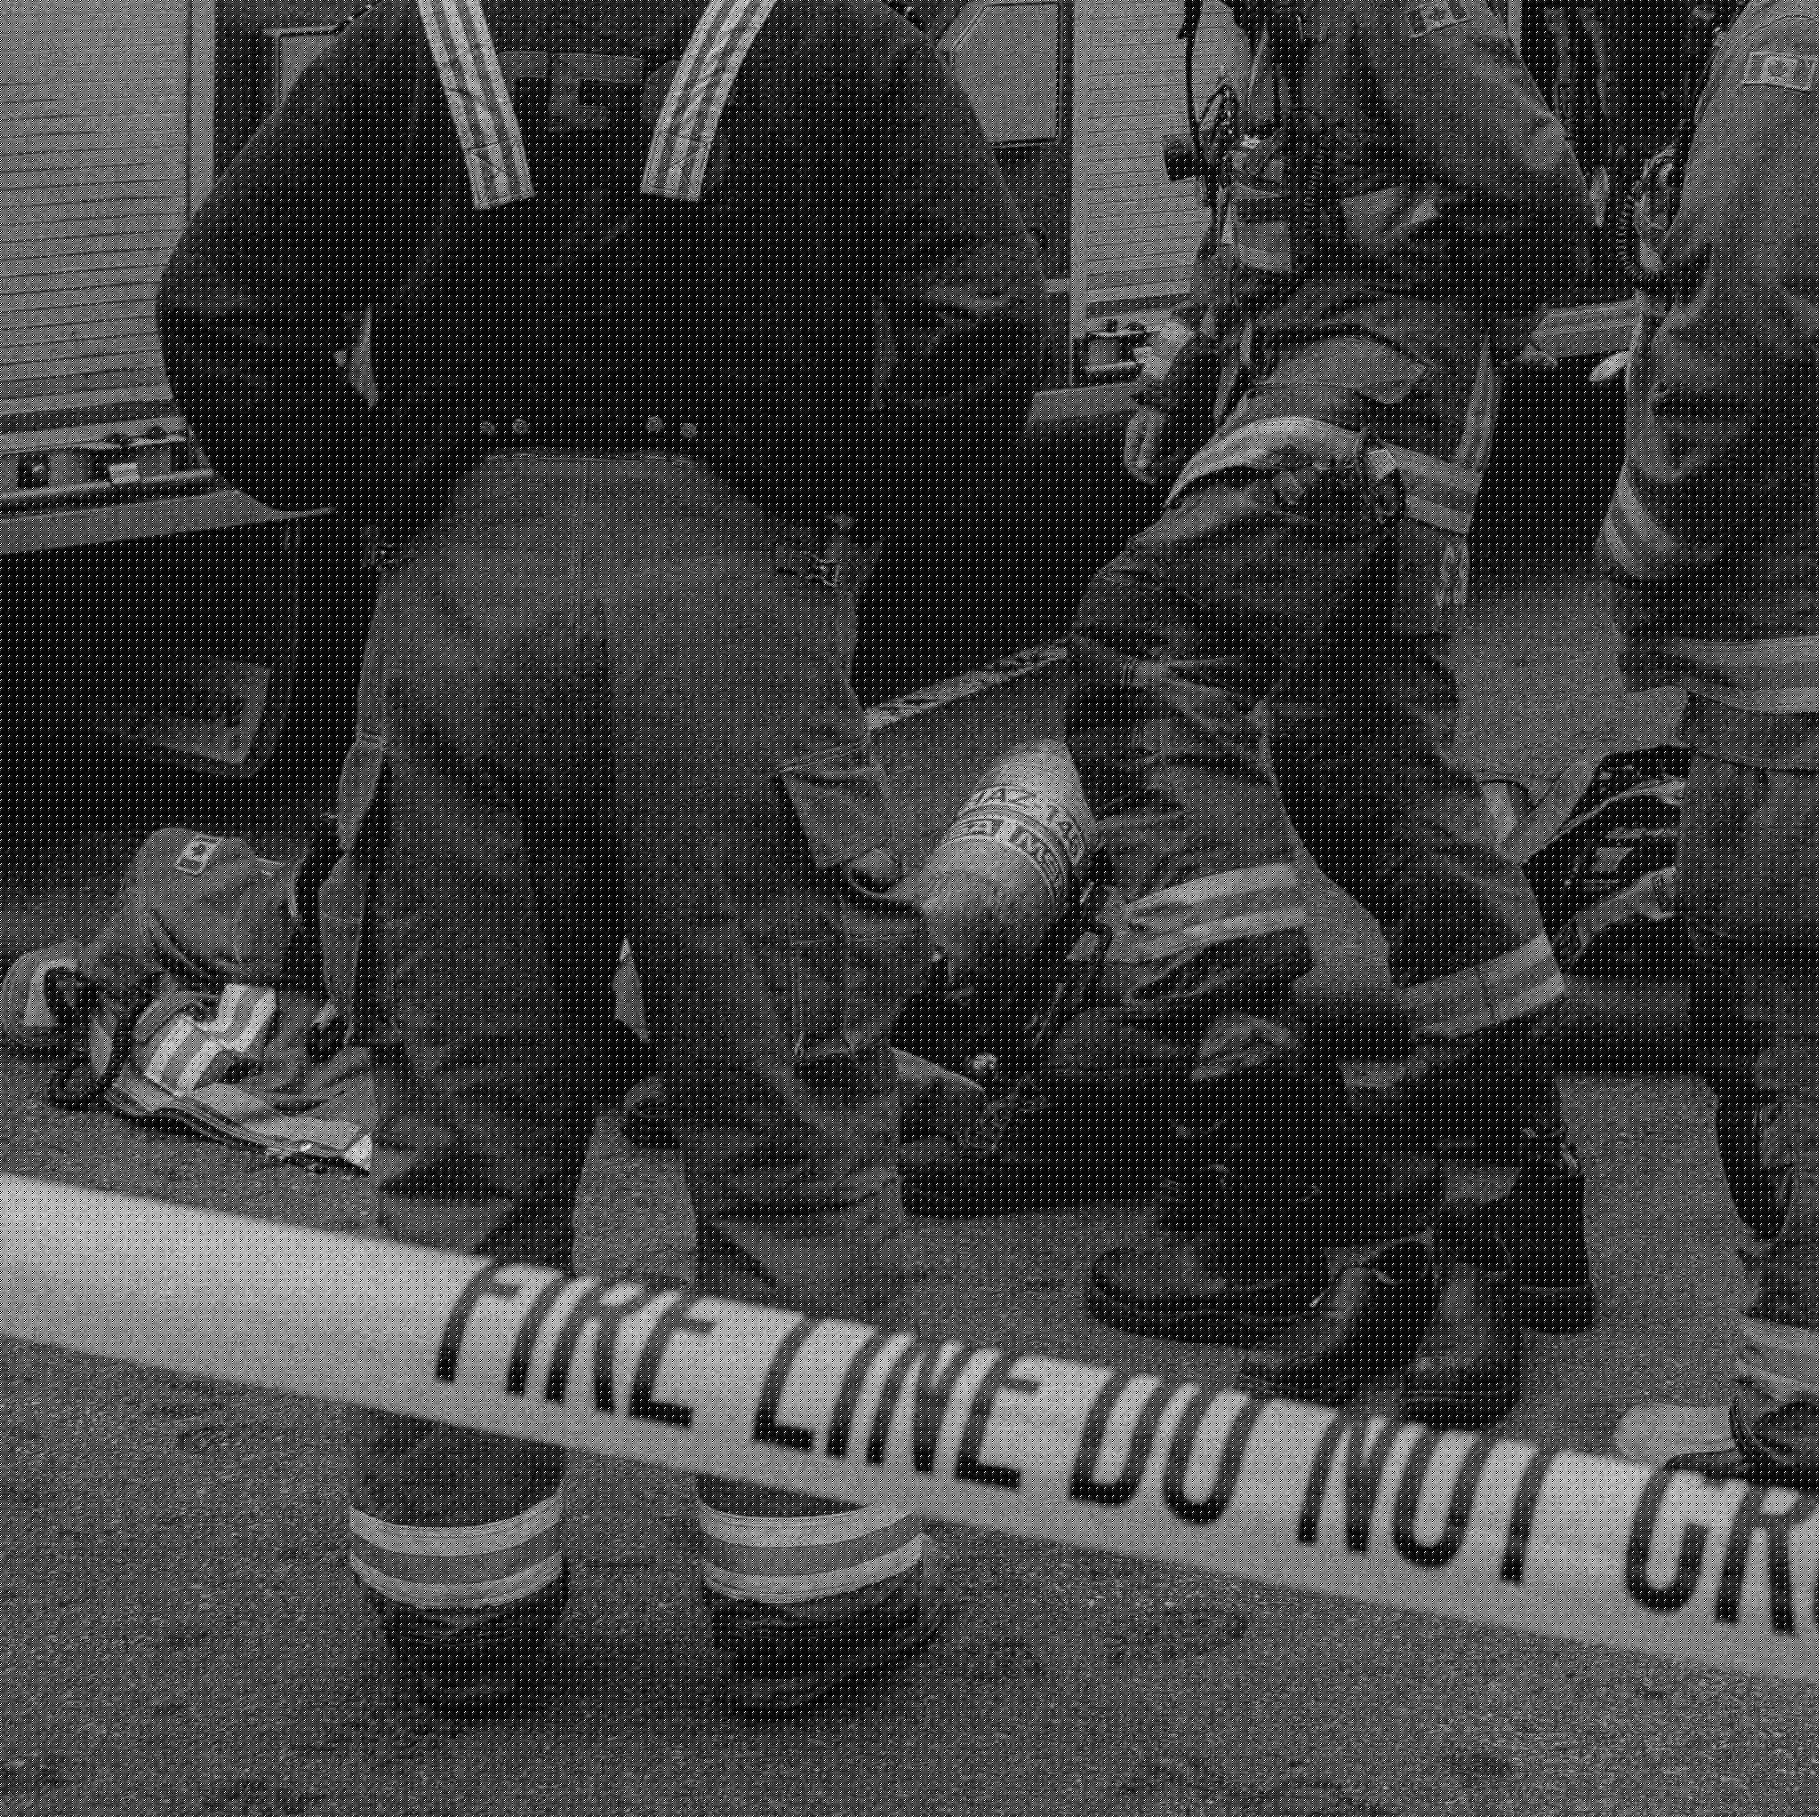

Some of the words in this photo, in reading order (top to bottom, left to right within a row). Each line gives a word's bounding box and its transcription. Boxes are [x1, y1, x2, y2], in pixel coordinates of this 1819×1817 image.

[436, 1264, 716, 1427] FIRE
[753, 1318, 1041, 1490] LINE
[1068, 1371, 1257, 1525] DO
[1297, 1412, 1552, 1584] NOT
